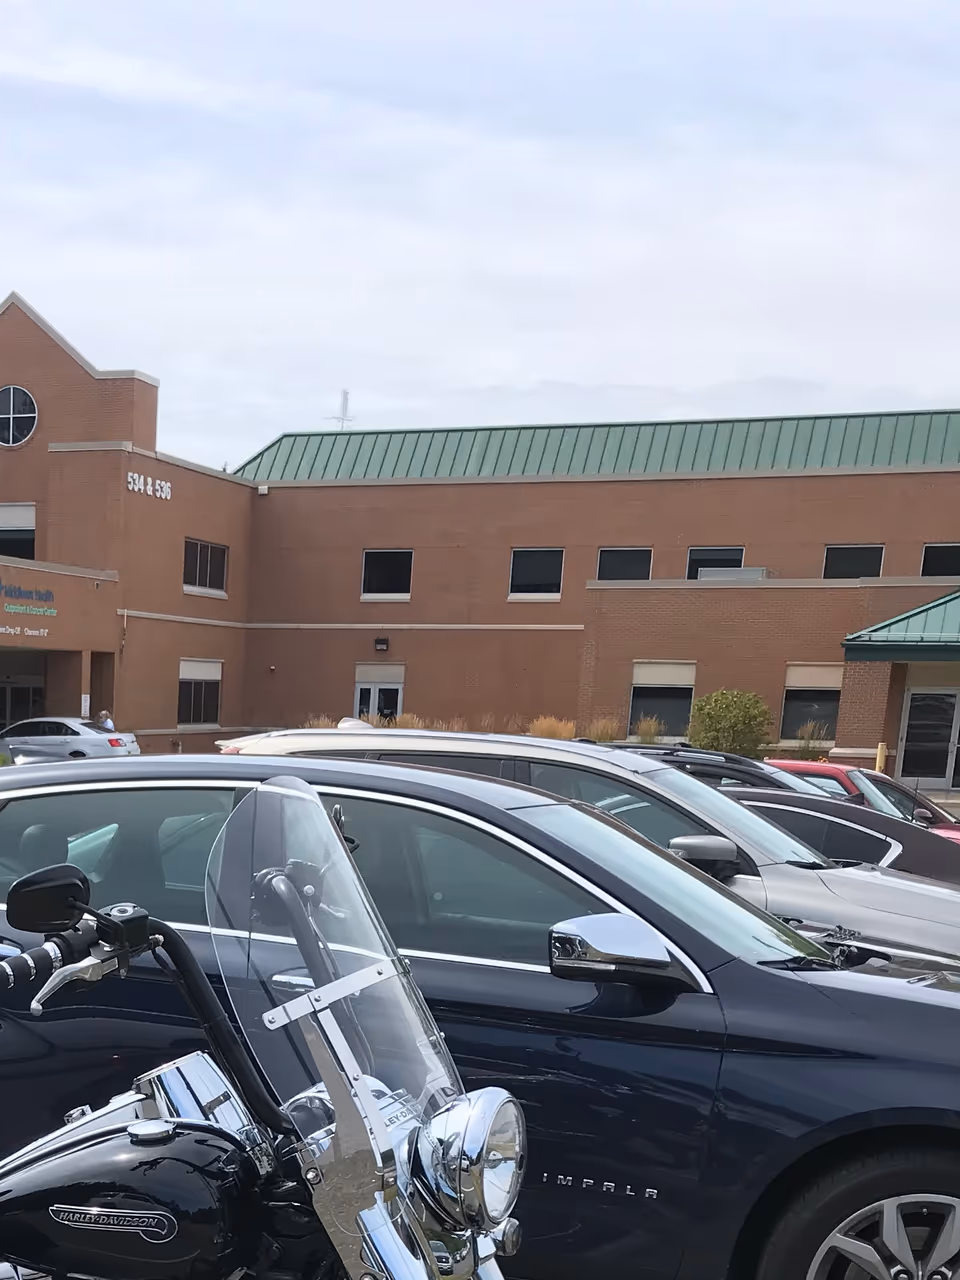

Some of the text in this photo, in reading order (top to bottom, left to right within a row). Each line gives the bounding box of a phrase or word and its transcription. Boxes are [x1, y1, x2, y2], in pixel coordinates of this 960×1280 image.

[127, 472, 172, 500] 534 & 536
[542, 1172, 658, 1199] IMPALA
[59, 1211, 158, 1227] HARLEY-DAVIDSON
